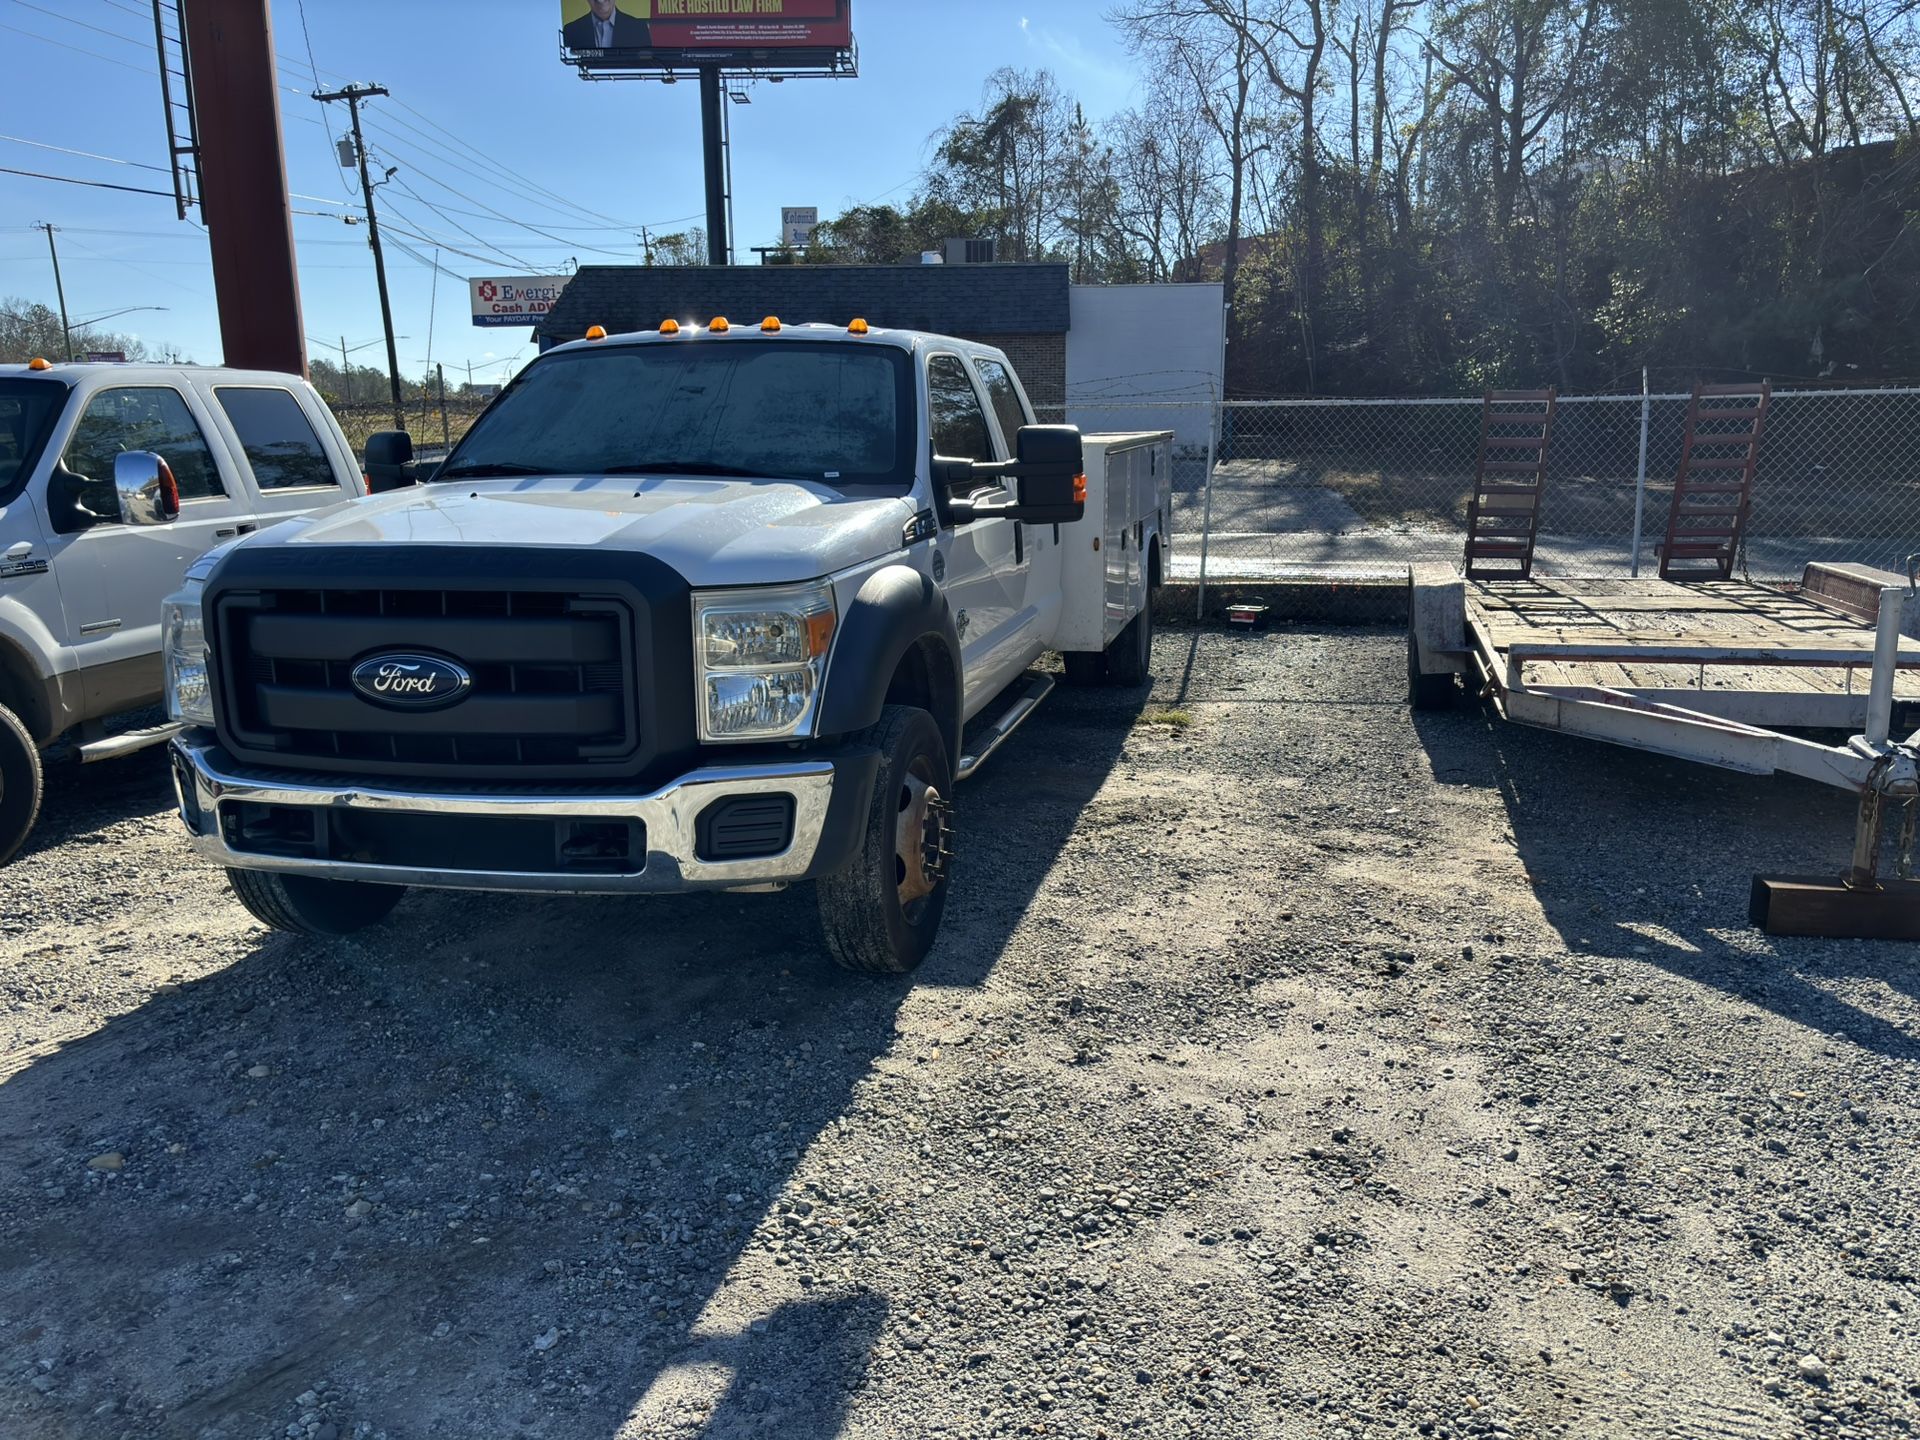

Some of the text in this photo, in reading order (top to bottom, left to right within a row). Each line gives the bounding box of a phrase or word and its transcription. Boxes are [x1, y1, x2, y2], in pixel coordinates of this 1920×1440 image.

[658, 0, 685, 14] MIKE
[731, 0, 754, 13] LAW
[492, 303, 523, 313] Cash
[374, 662, 437, 693] Ford
